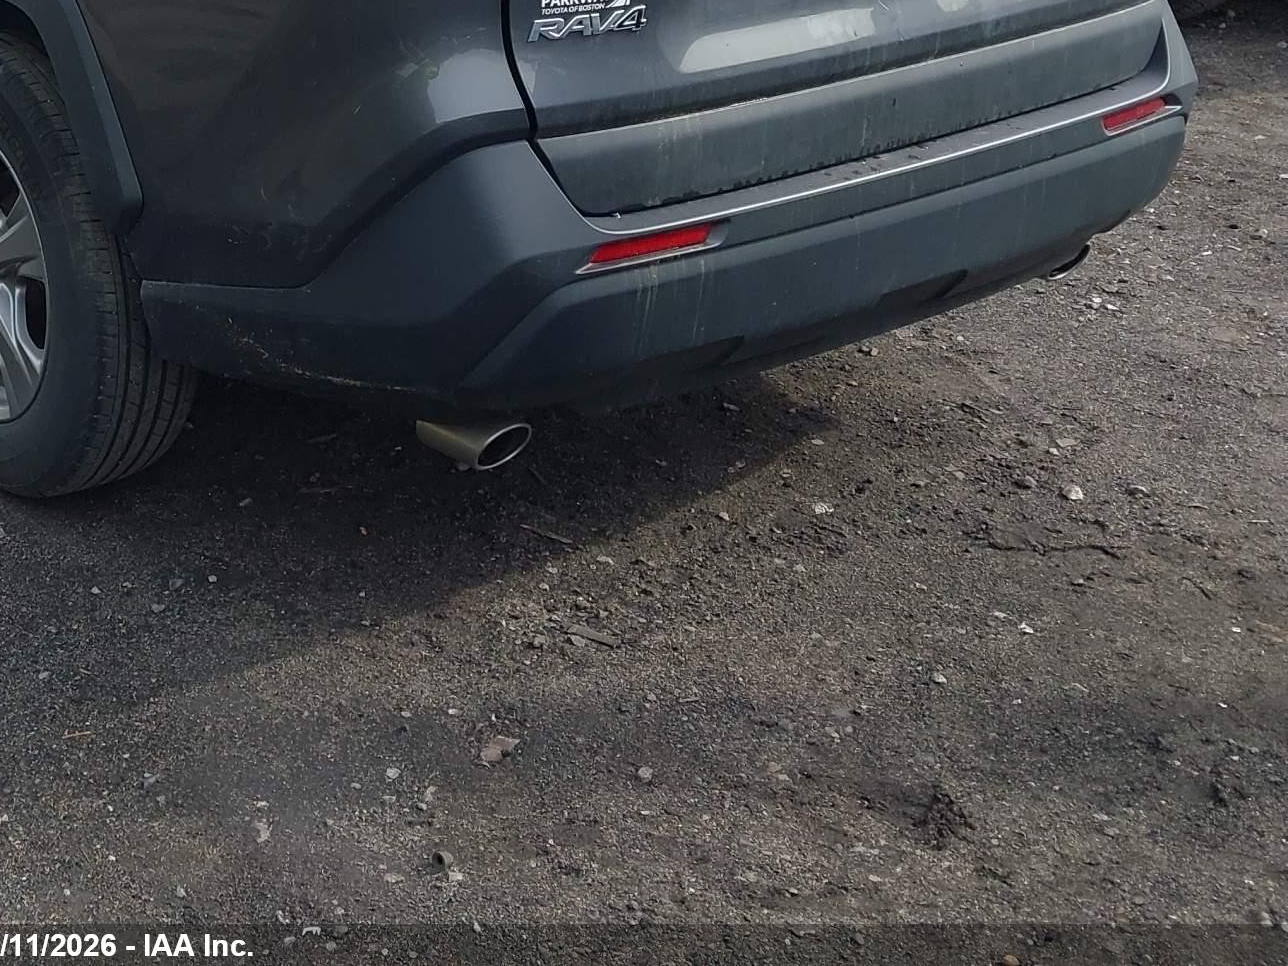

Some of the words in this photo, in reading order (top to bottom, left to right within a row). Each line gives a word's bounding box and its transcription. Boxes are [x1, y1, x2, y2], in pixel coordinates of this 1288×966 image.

[541, 7, 569, 16] TOYOTA
[568, 5, 579, 13] OF
[578, 2, 606, 12] BOSTON
[528, 4, 648, 42] RAV4
